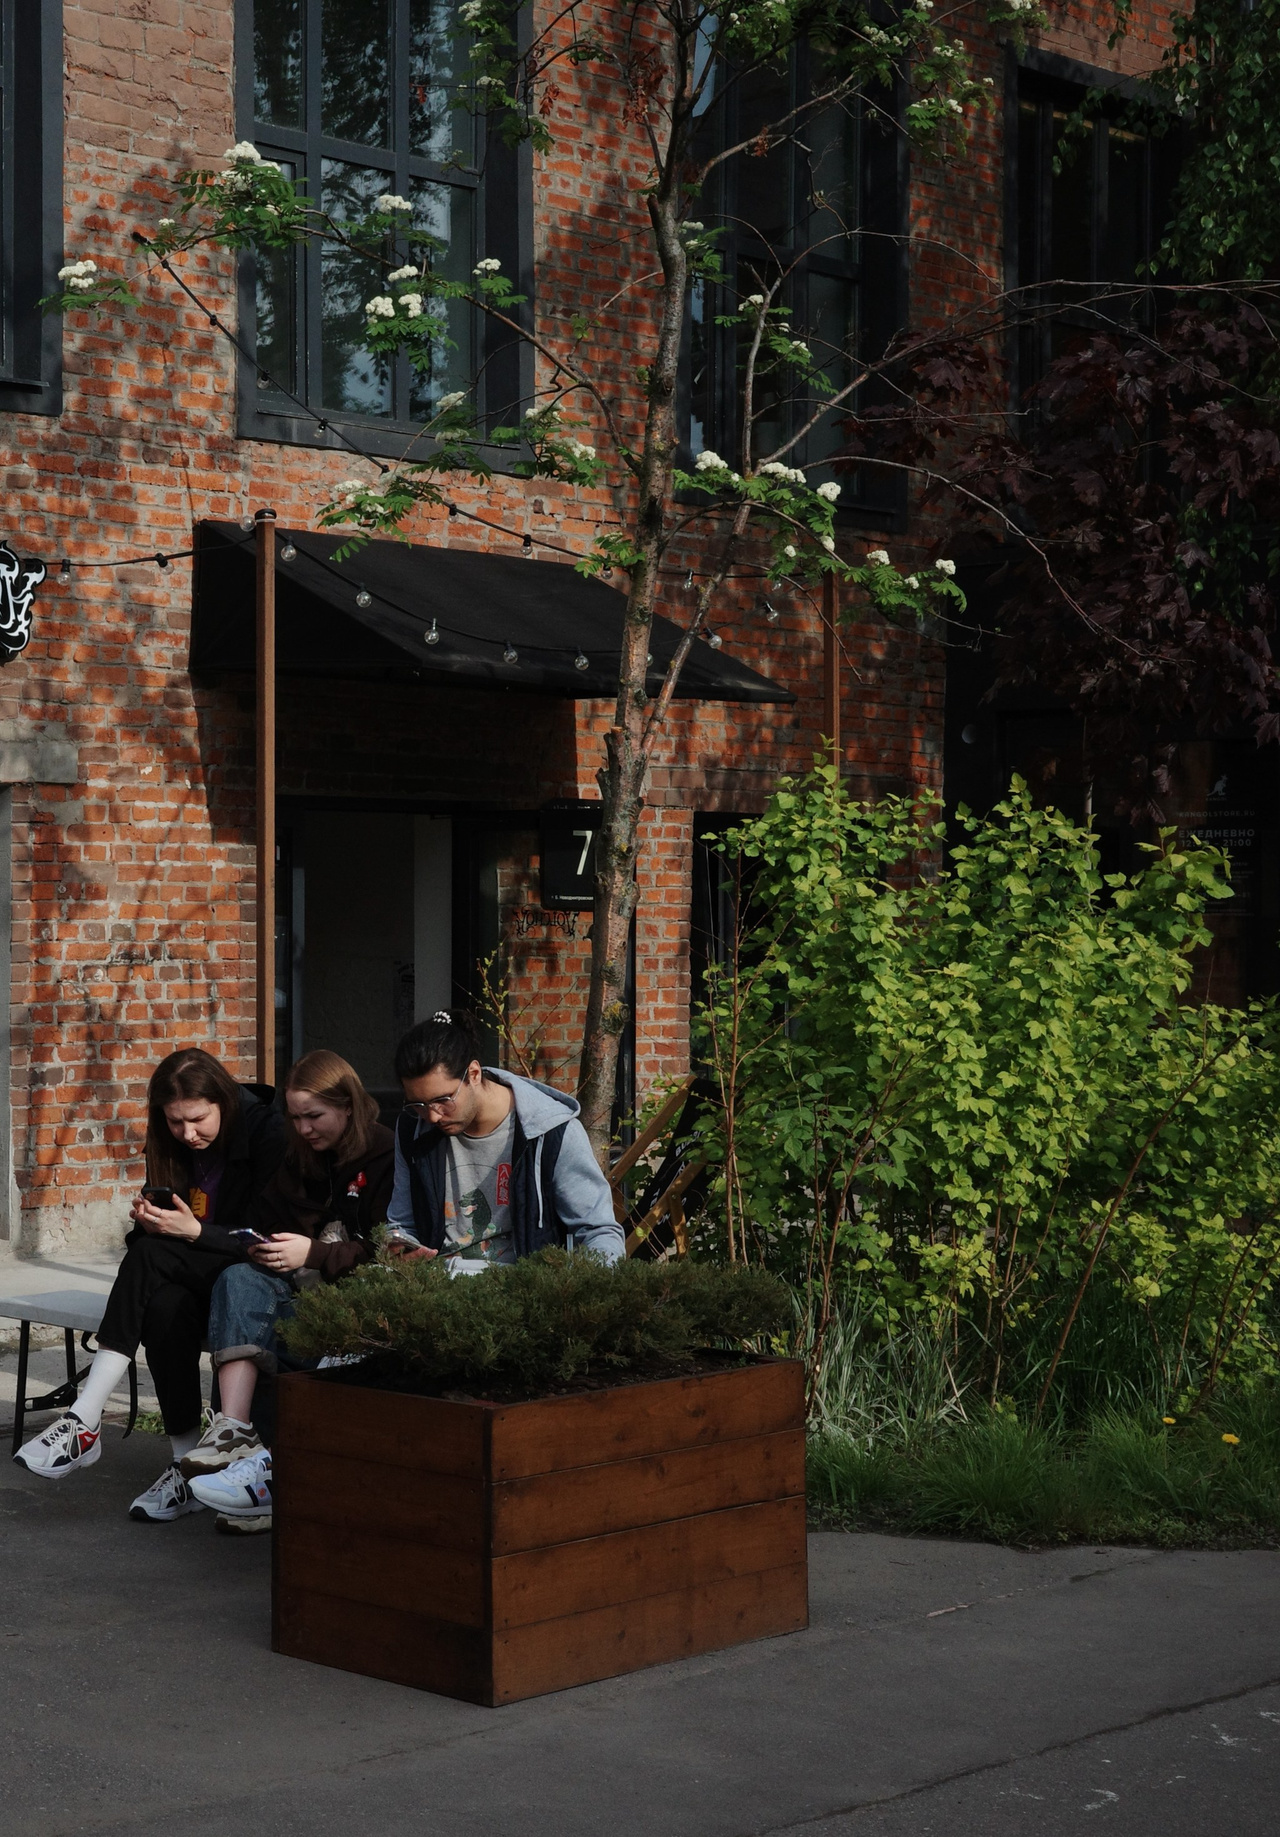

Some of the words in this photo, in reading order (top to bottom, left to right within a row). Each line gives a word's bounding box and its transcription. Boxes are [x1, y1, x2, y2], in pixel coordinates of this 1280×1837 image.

[1179, 829, 1255, 838] ЕЖЕДНЕВНО
[1181, 839, 1210, 848] 12:
[1223, 838, 1252, 847] 21:00
[573, 830, 593, 875] 7
